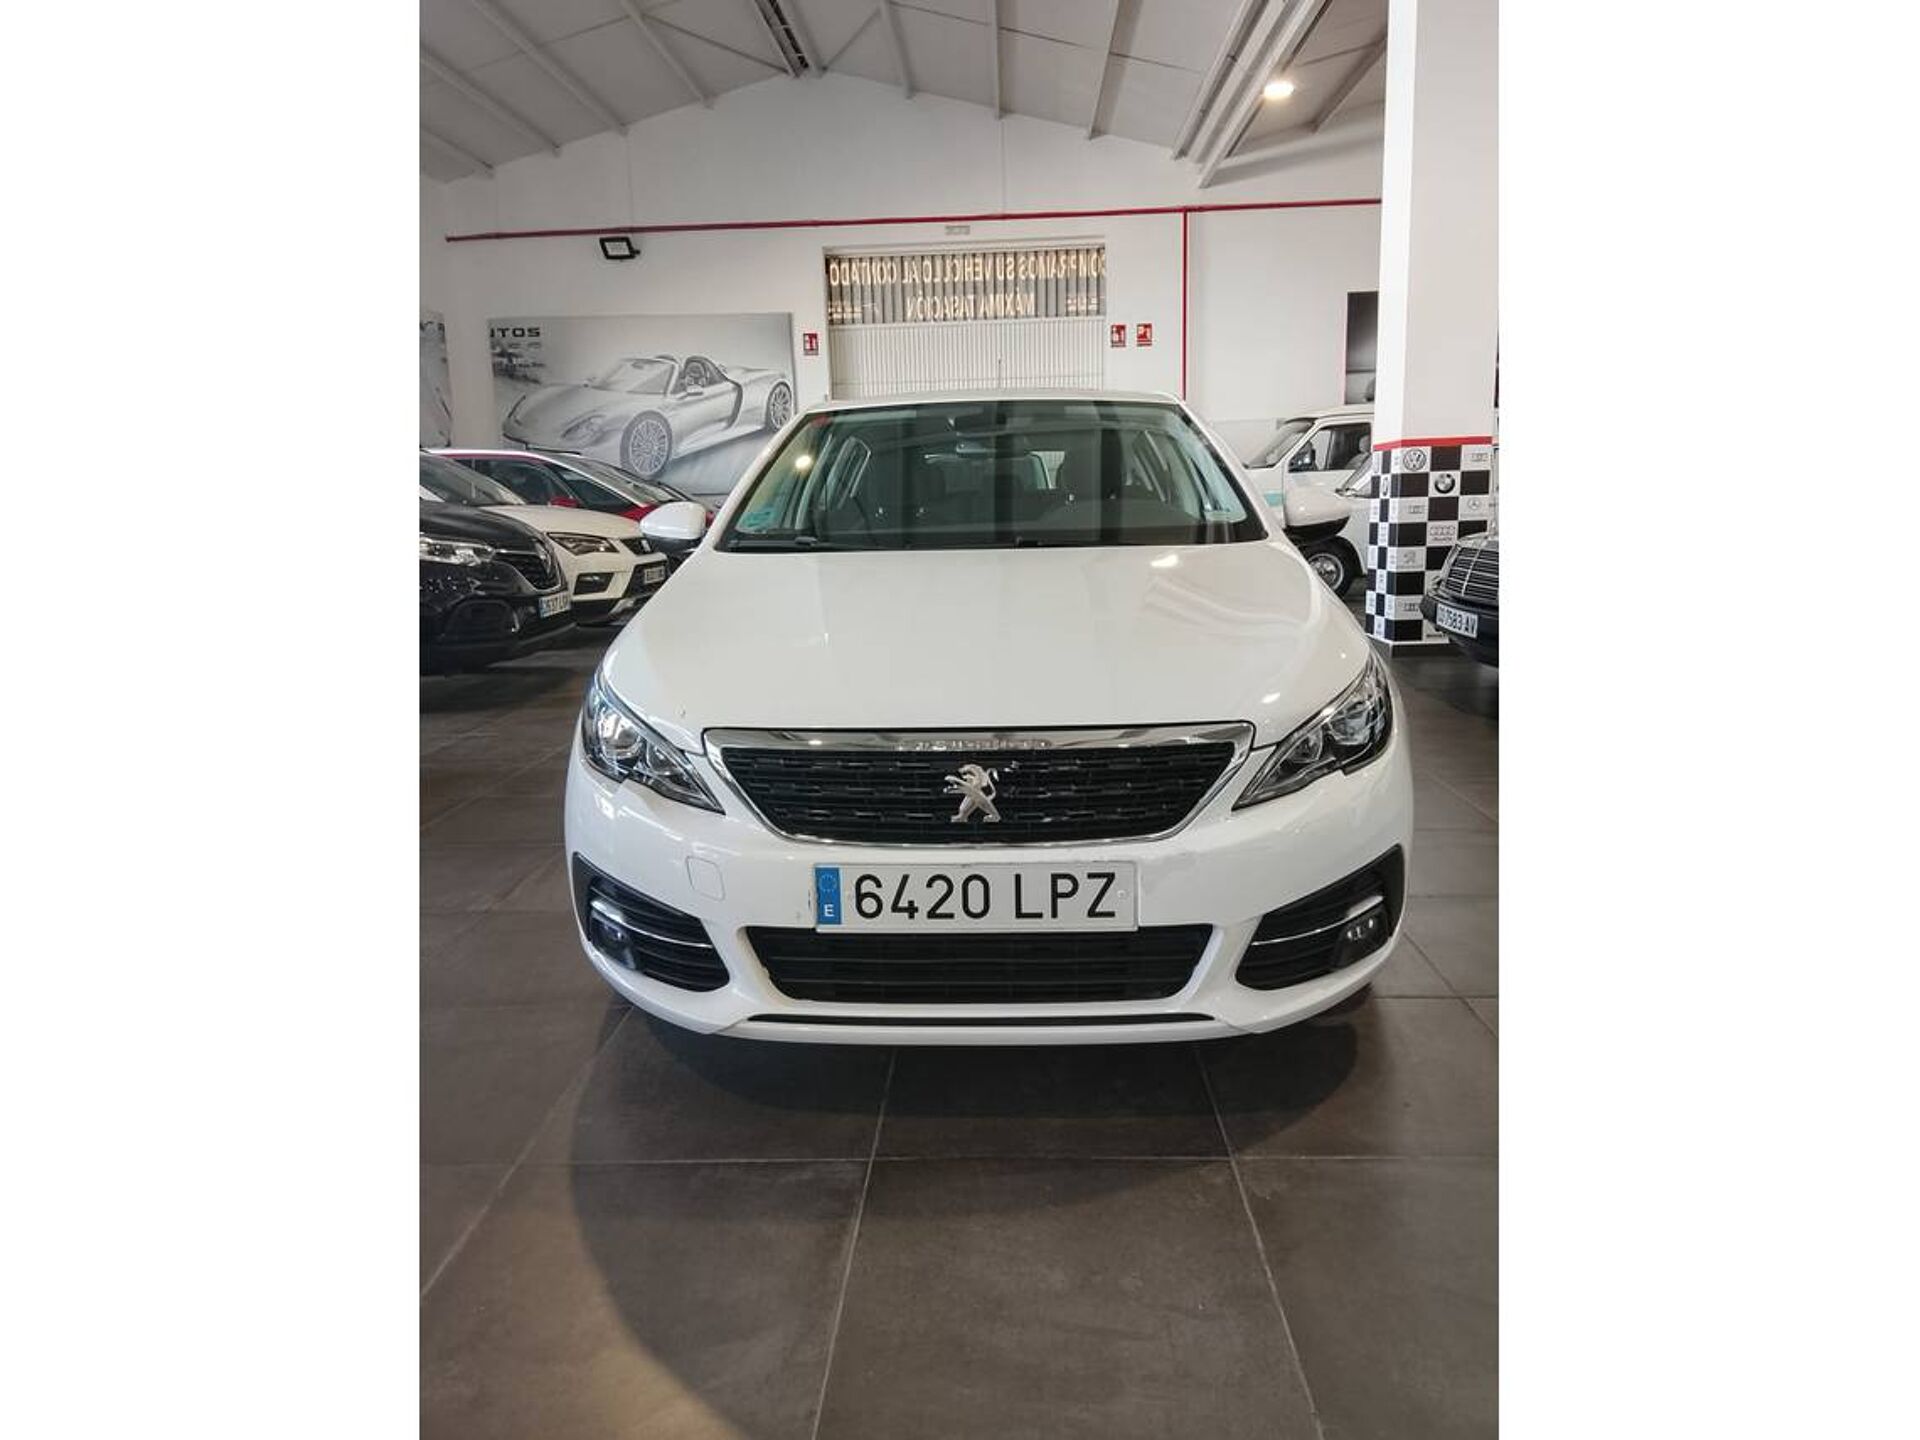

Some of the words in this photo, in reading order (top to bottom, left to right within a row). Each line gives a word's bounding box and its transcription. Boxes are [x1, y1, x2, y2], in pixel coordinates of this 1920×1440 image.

[824, 904, 834, 917] E
[854, 873, 991, 920] 6420
[1014, 872, 1116, 919] LPZ
